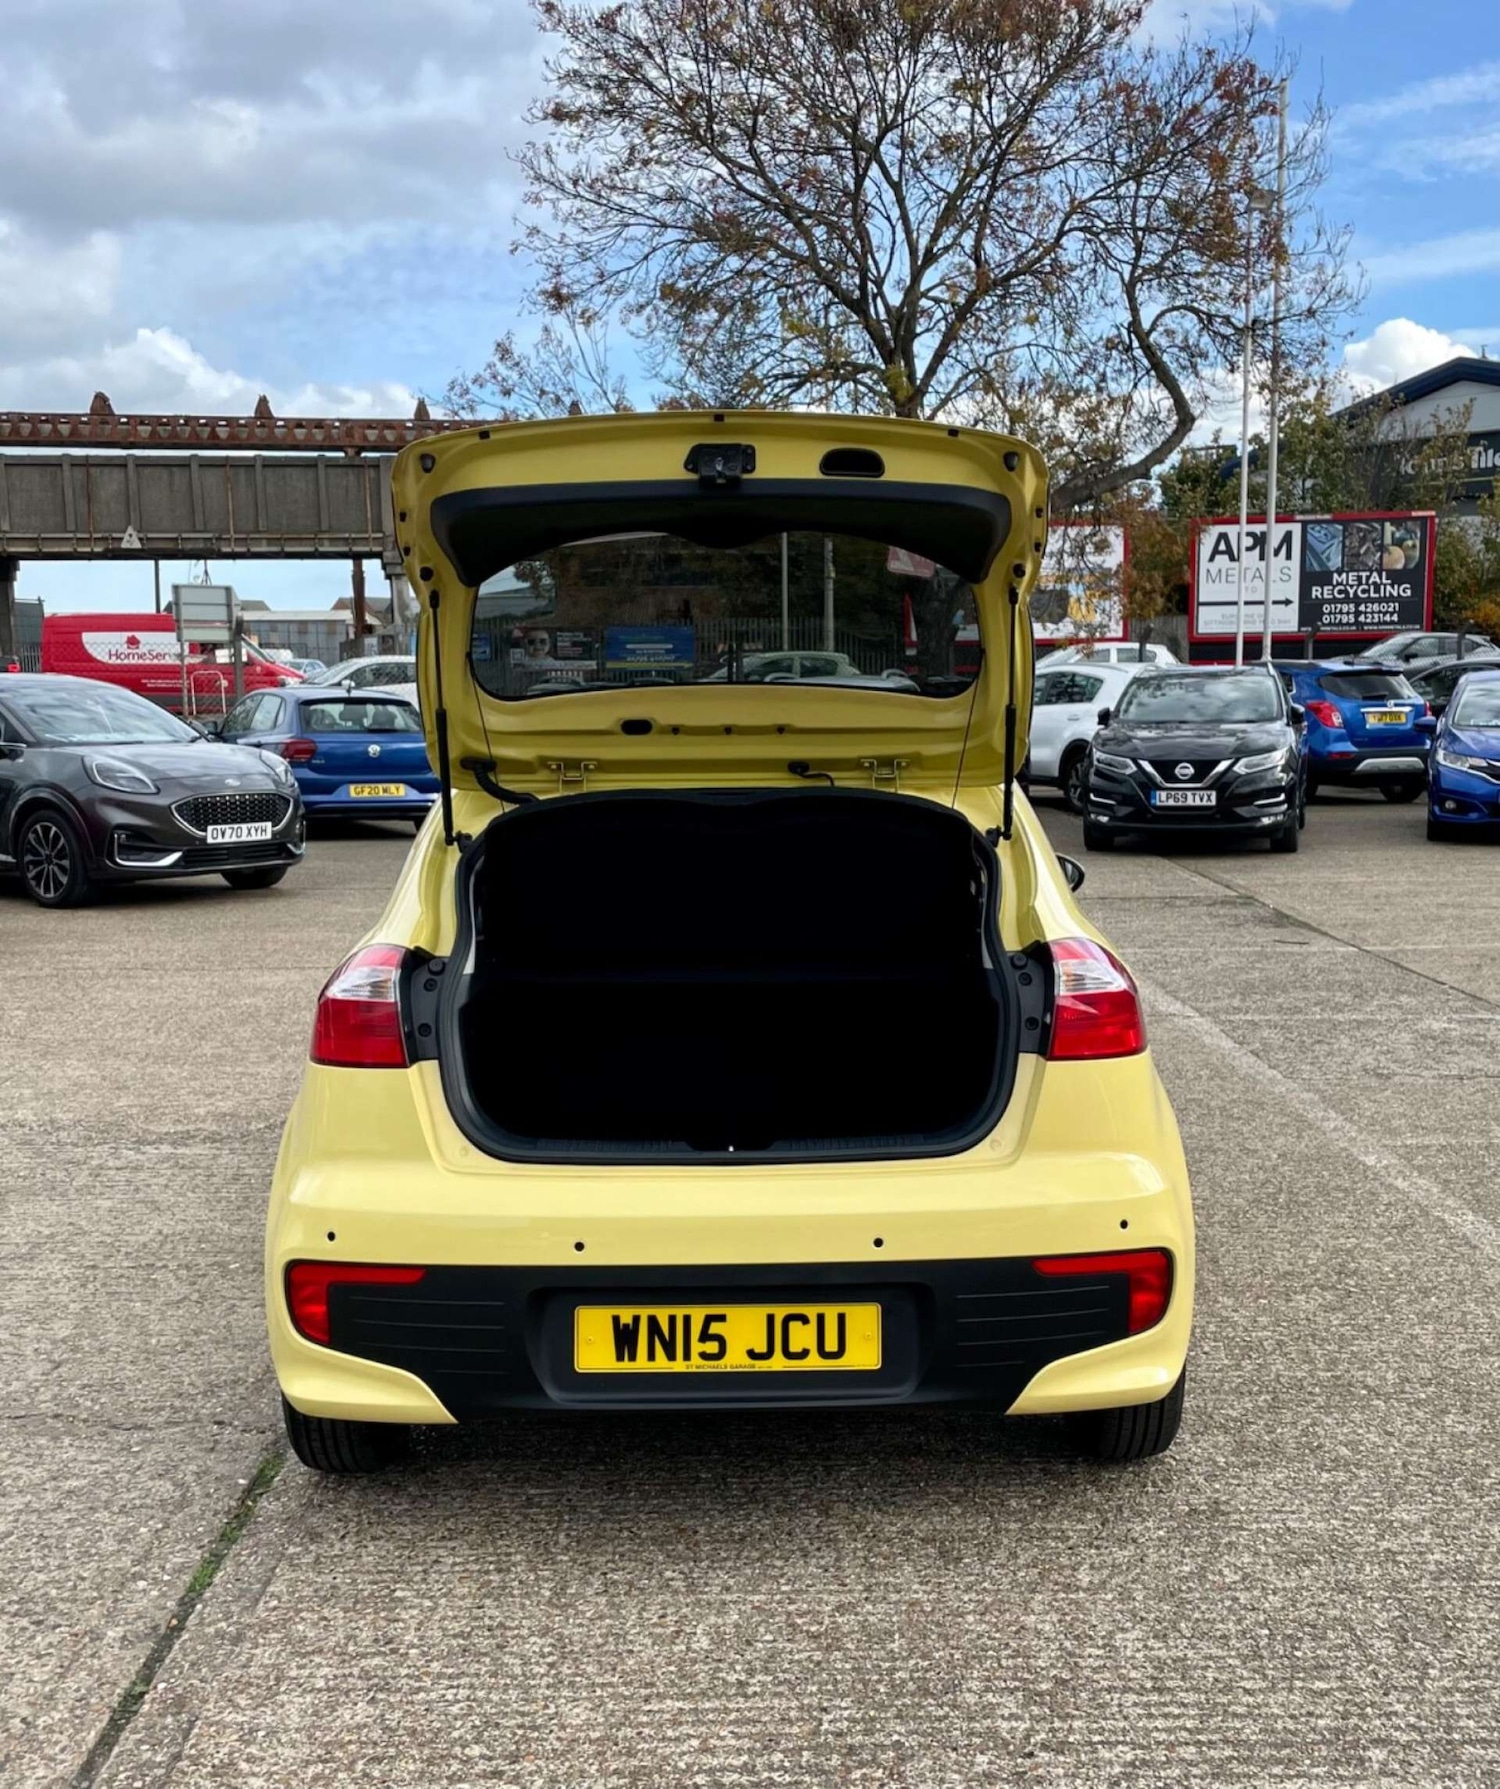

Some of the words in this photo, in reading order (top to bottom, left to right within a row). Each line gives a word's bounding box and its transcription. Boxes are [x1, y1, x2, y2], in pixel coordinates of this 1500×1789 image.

[1208, 530, 1293, 562] APM
[1206, 566, 1292, 584] METAS
[1332, 571, 1391, 585] METAL
[1311, 584, 1411, 599] RECYCLING
[1322, 603, 1355, 613] 01795
[1358, 602, 1399, 612] 426021
[1322, 614, 1355, 624] 01795
[1358, 613, 1399, 623] 423144
[108, 649, 180, 661] HomeSer
[353, 786, 380, 795] GF20
[382, 786, 401, 795] MLY
[1159, 792, 1188, 803] LP69
[1190, 792, 1213, 803] TVX
[211, 826, 243, 840] OV70
[246, 824, 267, 838] XYH
[612, 1314, 727, 1362] WN15
[746, 1312, 846, 1361] JCU
